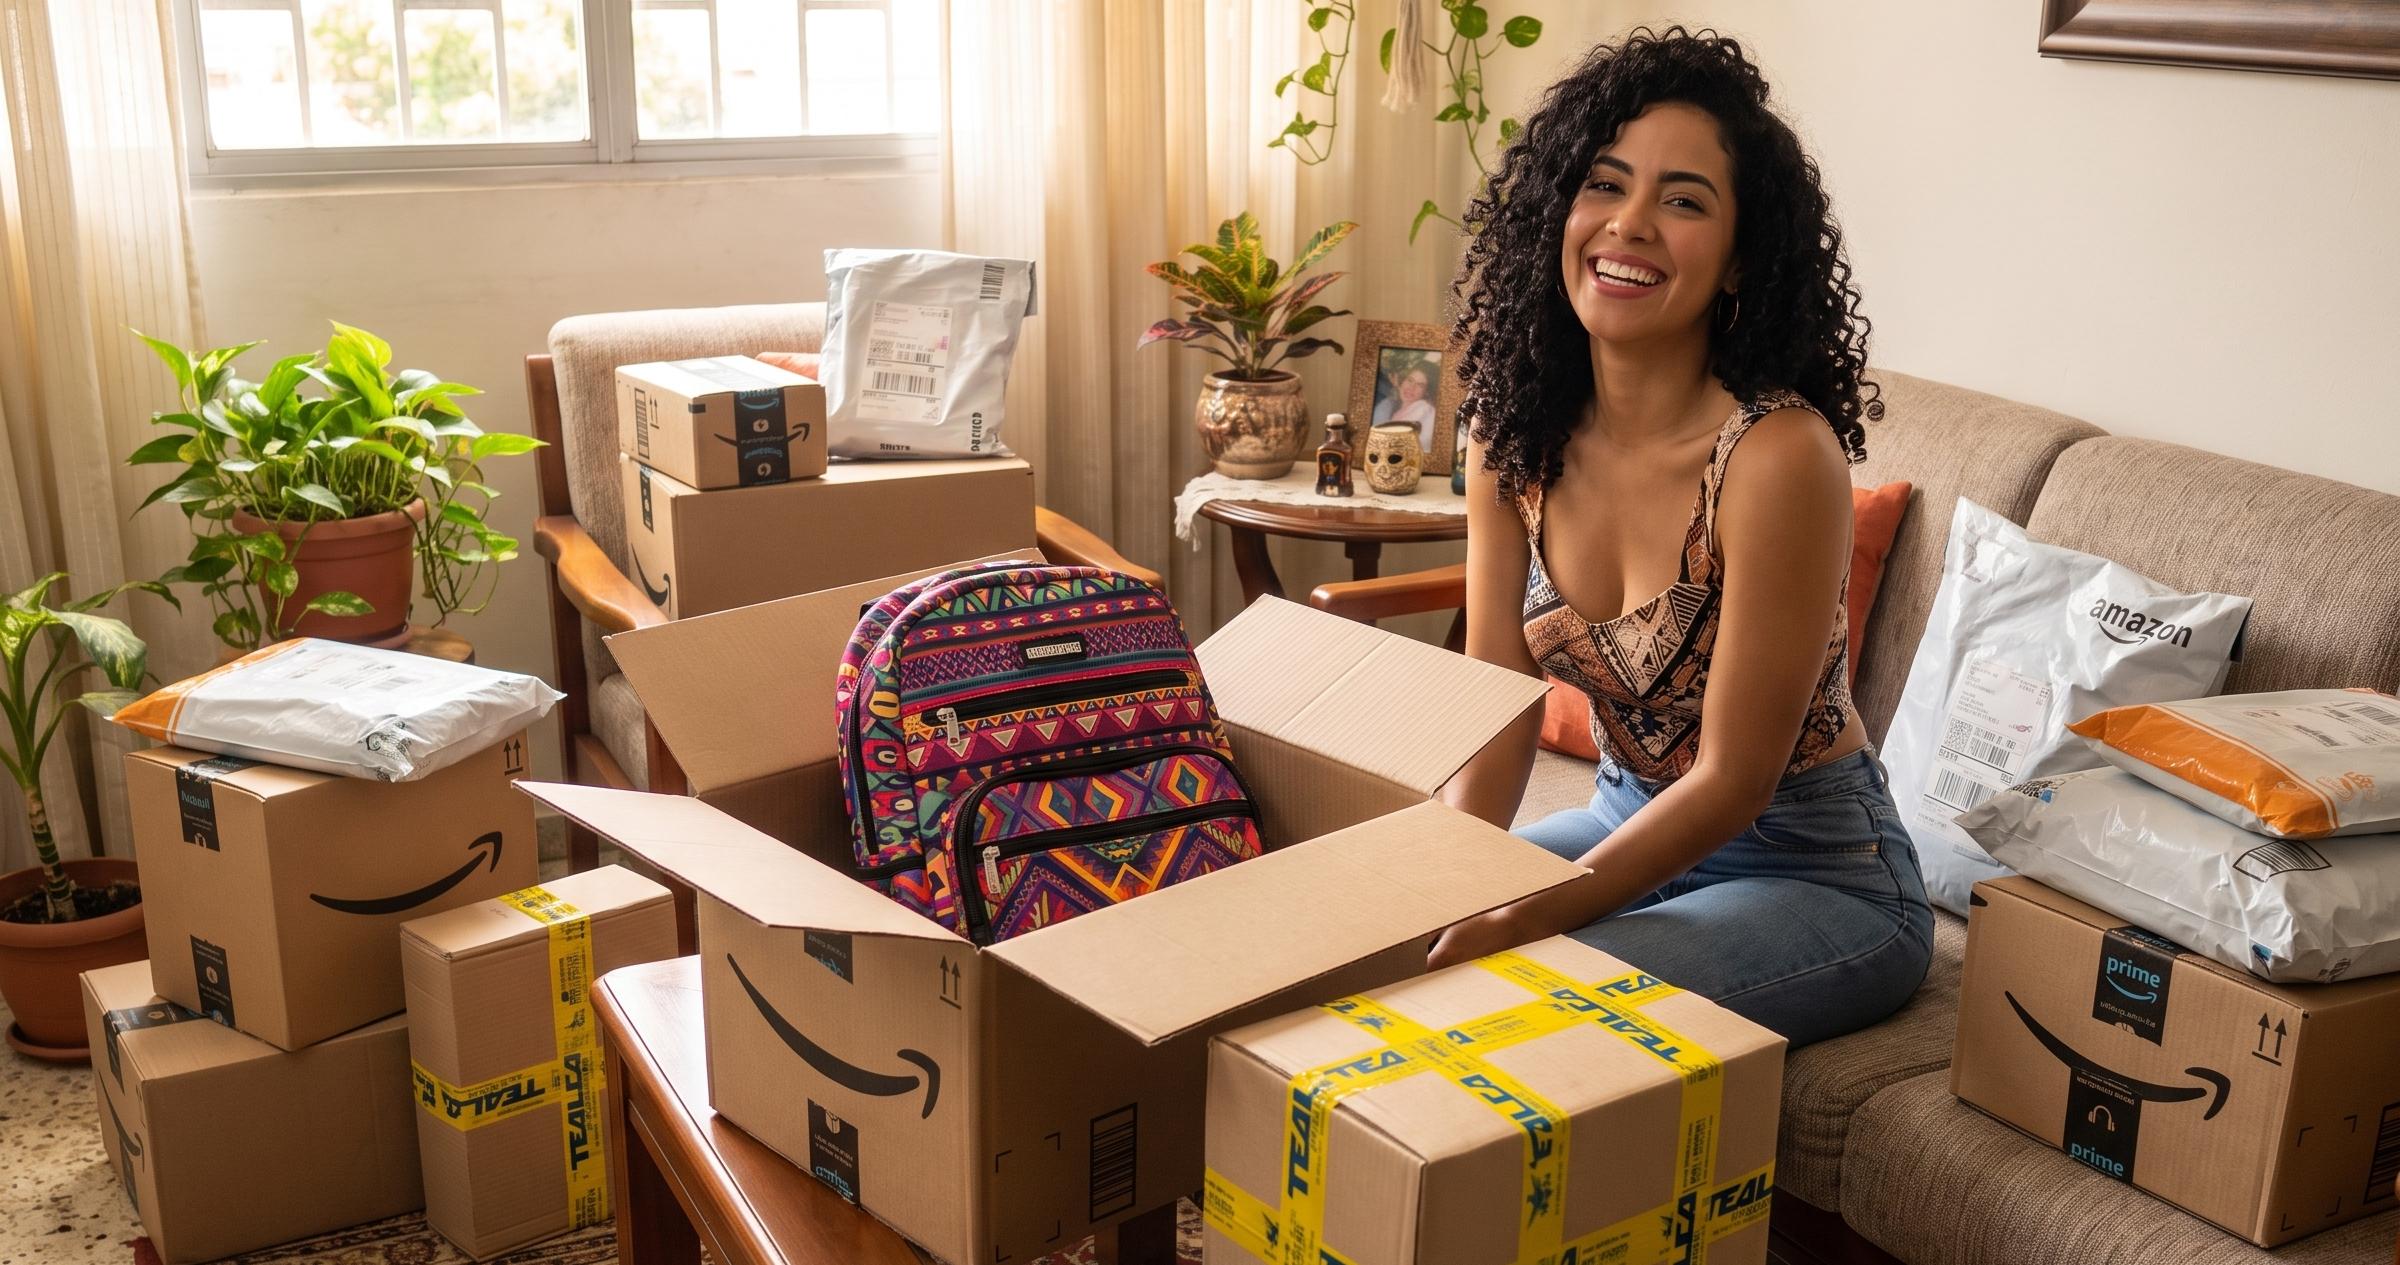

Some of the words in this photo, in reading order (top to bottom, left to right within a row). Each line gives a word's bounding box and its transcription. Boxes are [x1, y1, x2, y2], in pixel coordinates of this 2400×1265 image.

[2089, 598, 2193, 648] amazon
[2106, 956, 2160, 988] prime
[562, 1052, 590, 1172] TEALCA
[2071, 1142, 2124, 1177] prime
